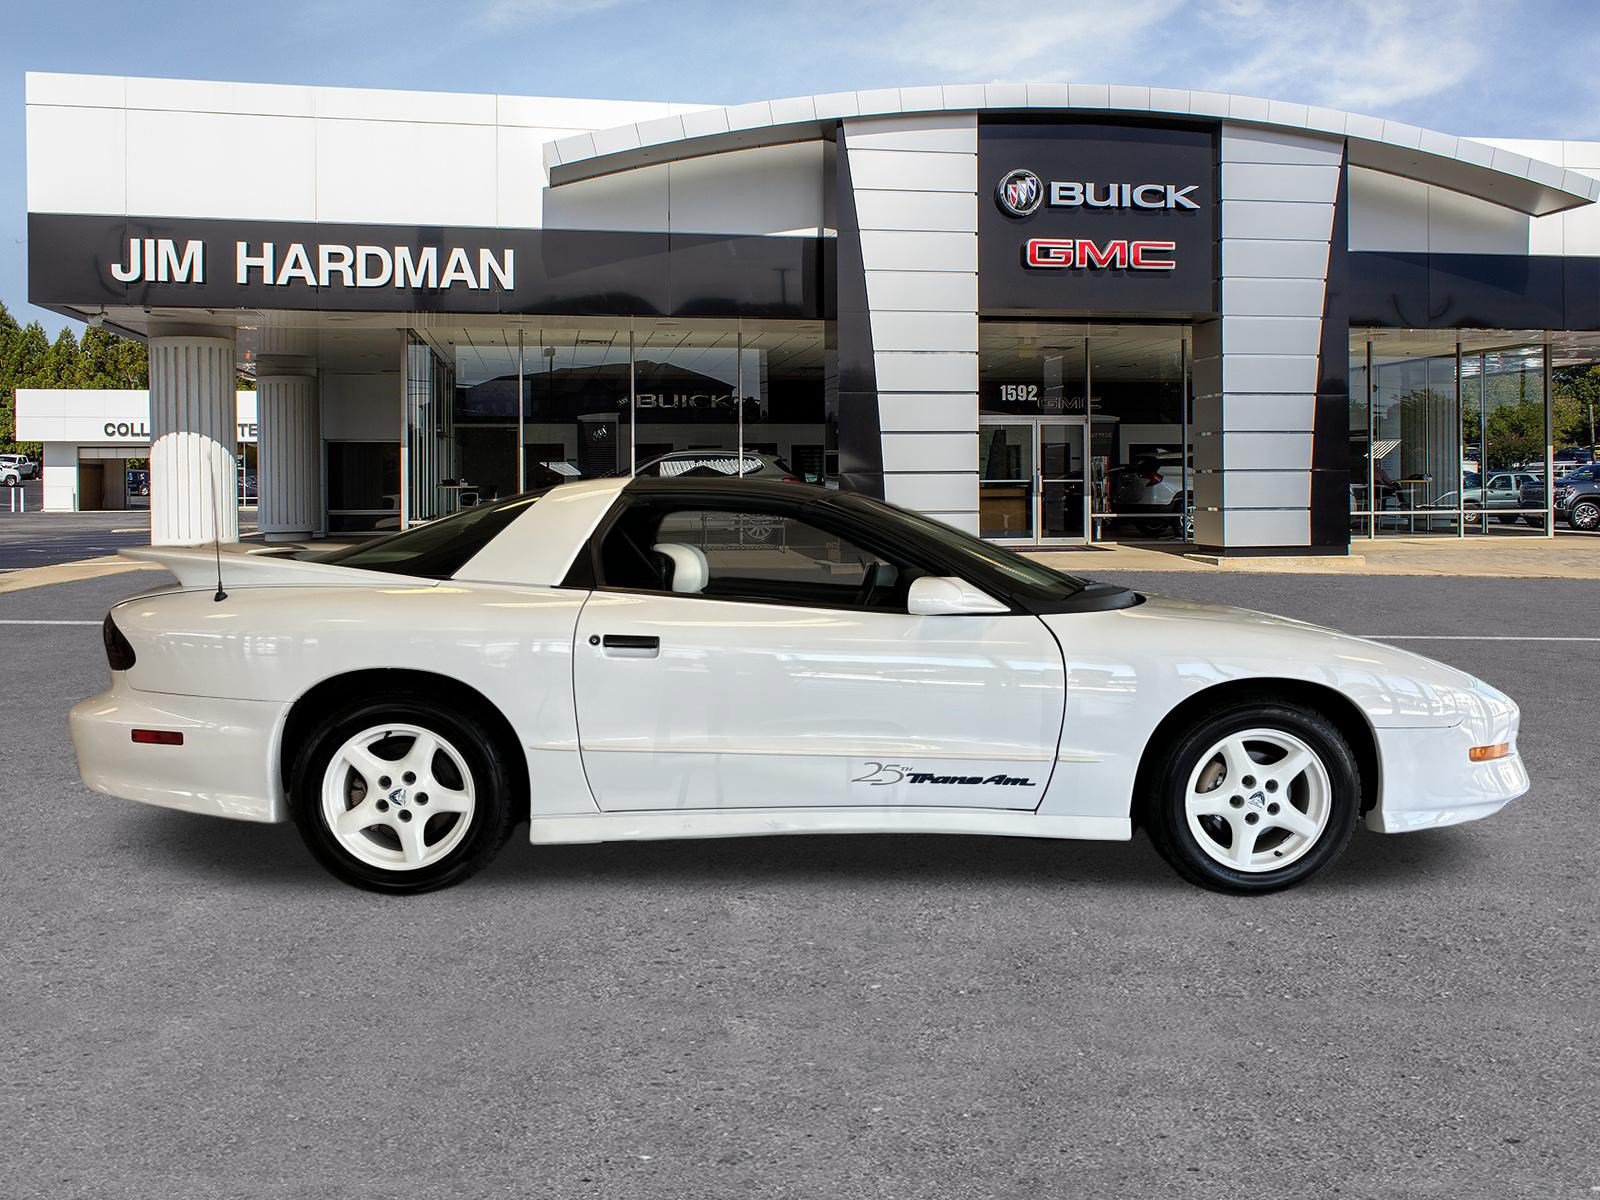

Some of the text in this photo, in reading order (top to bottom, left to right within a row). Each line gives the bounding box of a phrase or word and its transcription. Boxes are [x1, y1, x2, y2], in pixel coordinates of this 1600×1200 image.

[1050, 181, 1200, 209] BUICK
[1026, 238, 1176, 270] GMC
[111, 238, 515, 291] JIM HARDMAN
[1000, 384, 1038, 401] 1592
[636, 394, 730, 409] BUICK
[1037, 396, 1103, 409] GMC
[104, 422, 150, 438] COLL
[906, 772, 984, 785] Trans
[982, 774, 1037, 787] Am
